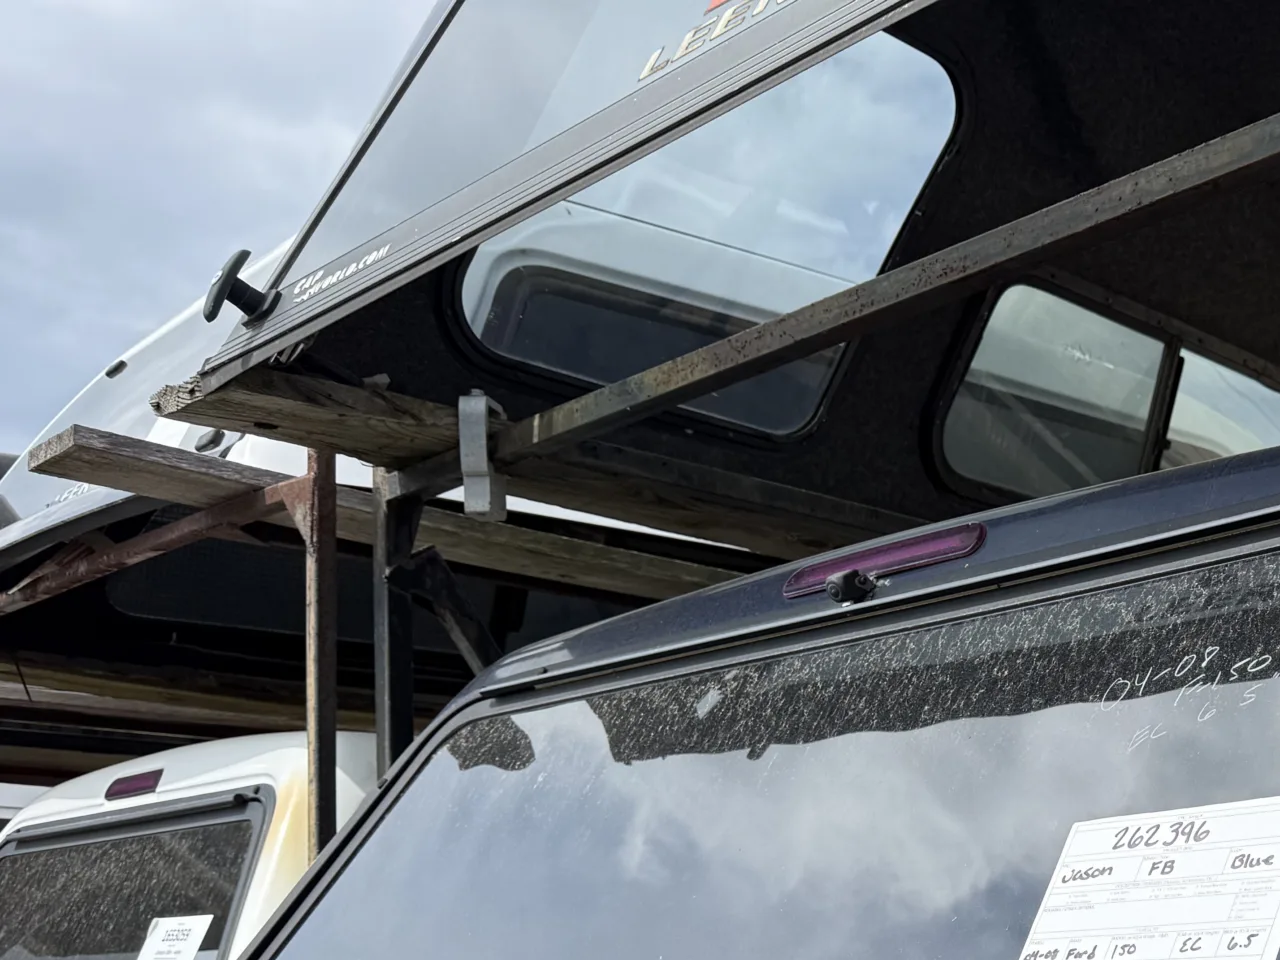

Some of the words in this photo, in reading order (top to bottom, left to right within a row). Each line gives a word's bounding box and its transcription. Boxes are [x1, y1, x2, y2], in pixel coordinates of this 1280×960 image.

[637, 0, 788, 82] LEE
[1147, 859, 1176, 877] FB
[1230, 853, 1275, 870] Blue
[1065, 944, 1098, 960] Ford
[1110, 943, 1137, 960] 150
[1226, 933, 1260, 951] 6.5
